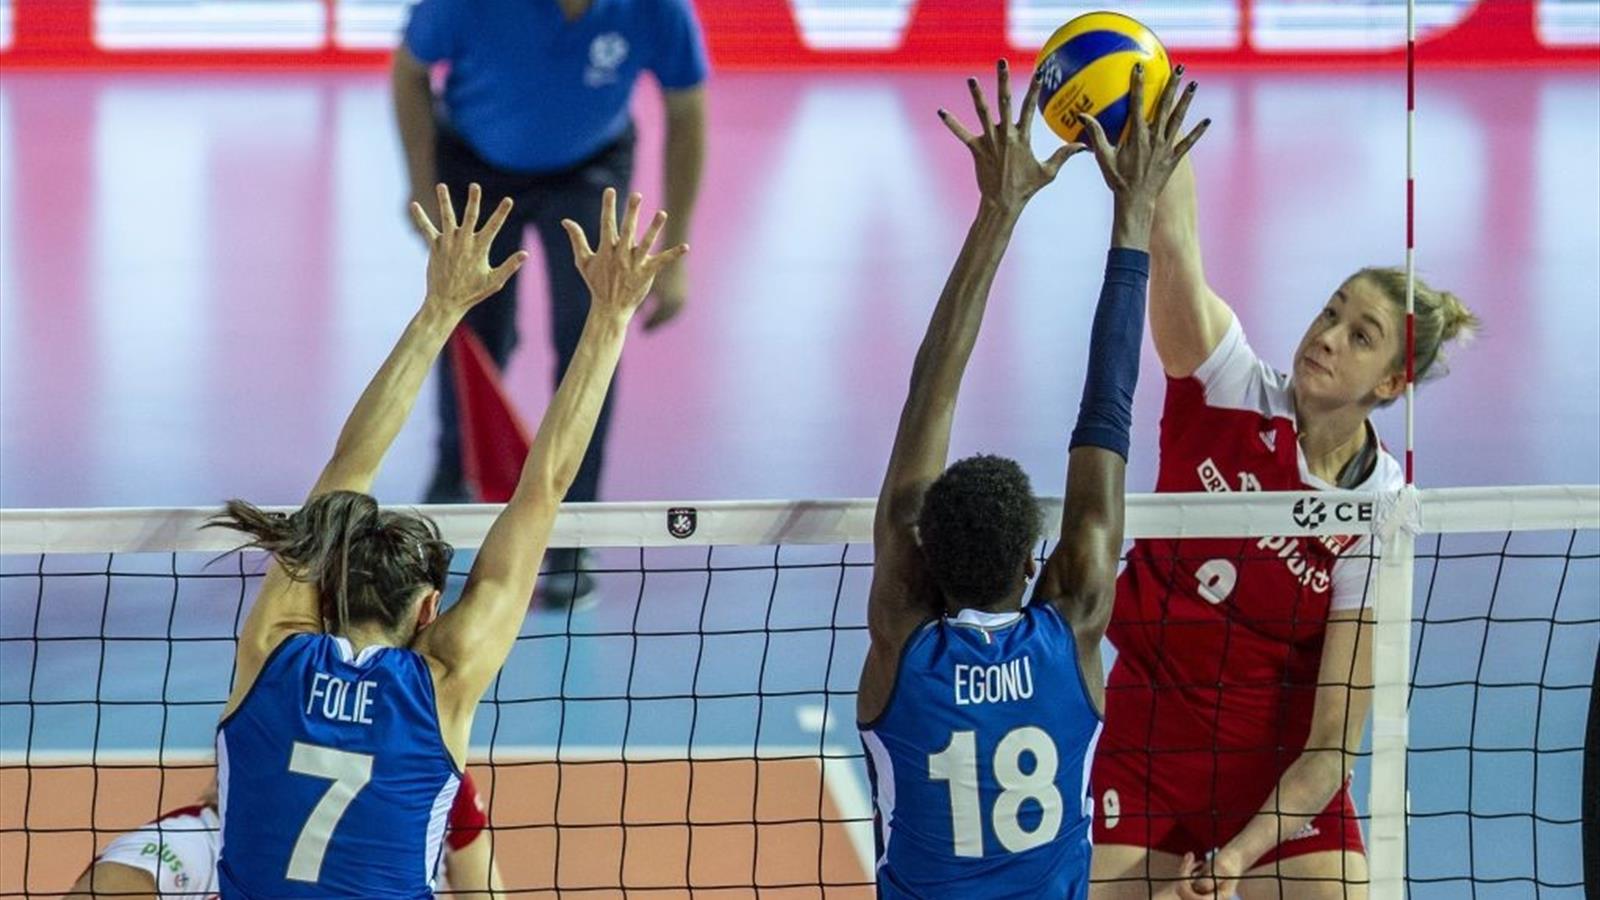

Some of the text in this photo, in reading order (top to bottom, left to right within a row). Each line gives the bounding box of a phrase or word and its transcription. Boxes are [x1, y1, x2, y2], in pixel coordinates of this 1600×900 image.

[1201, 465, 1227, 492] OR
[1335, 503, 1373, 522] CE
[306, 672, 378, 725] FOLIE
[955, 656, 1034, 705] EGONU
[285, 741, 375, 883] 7
[928, 726, 1064, 858] 18
[140, 842, 184, 873] plus
